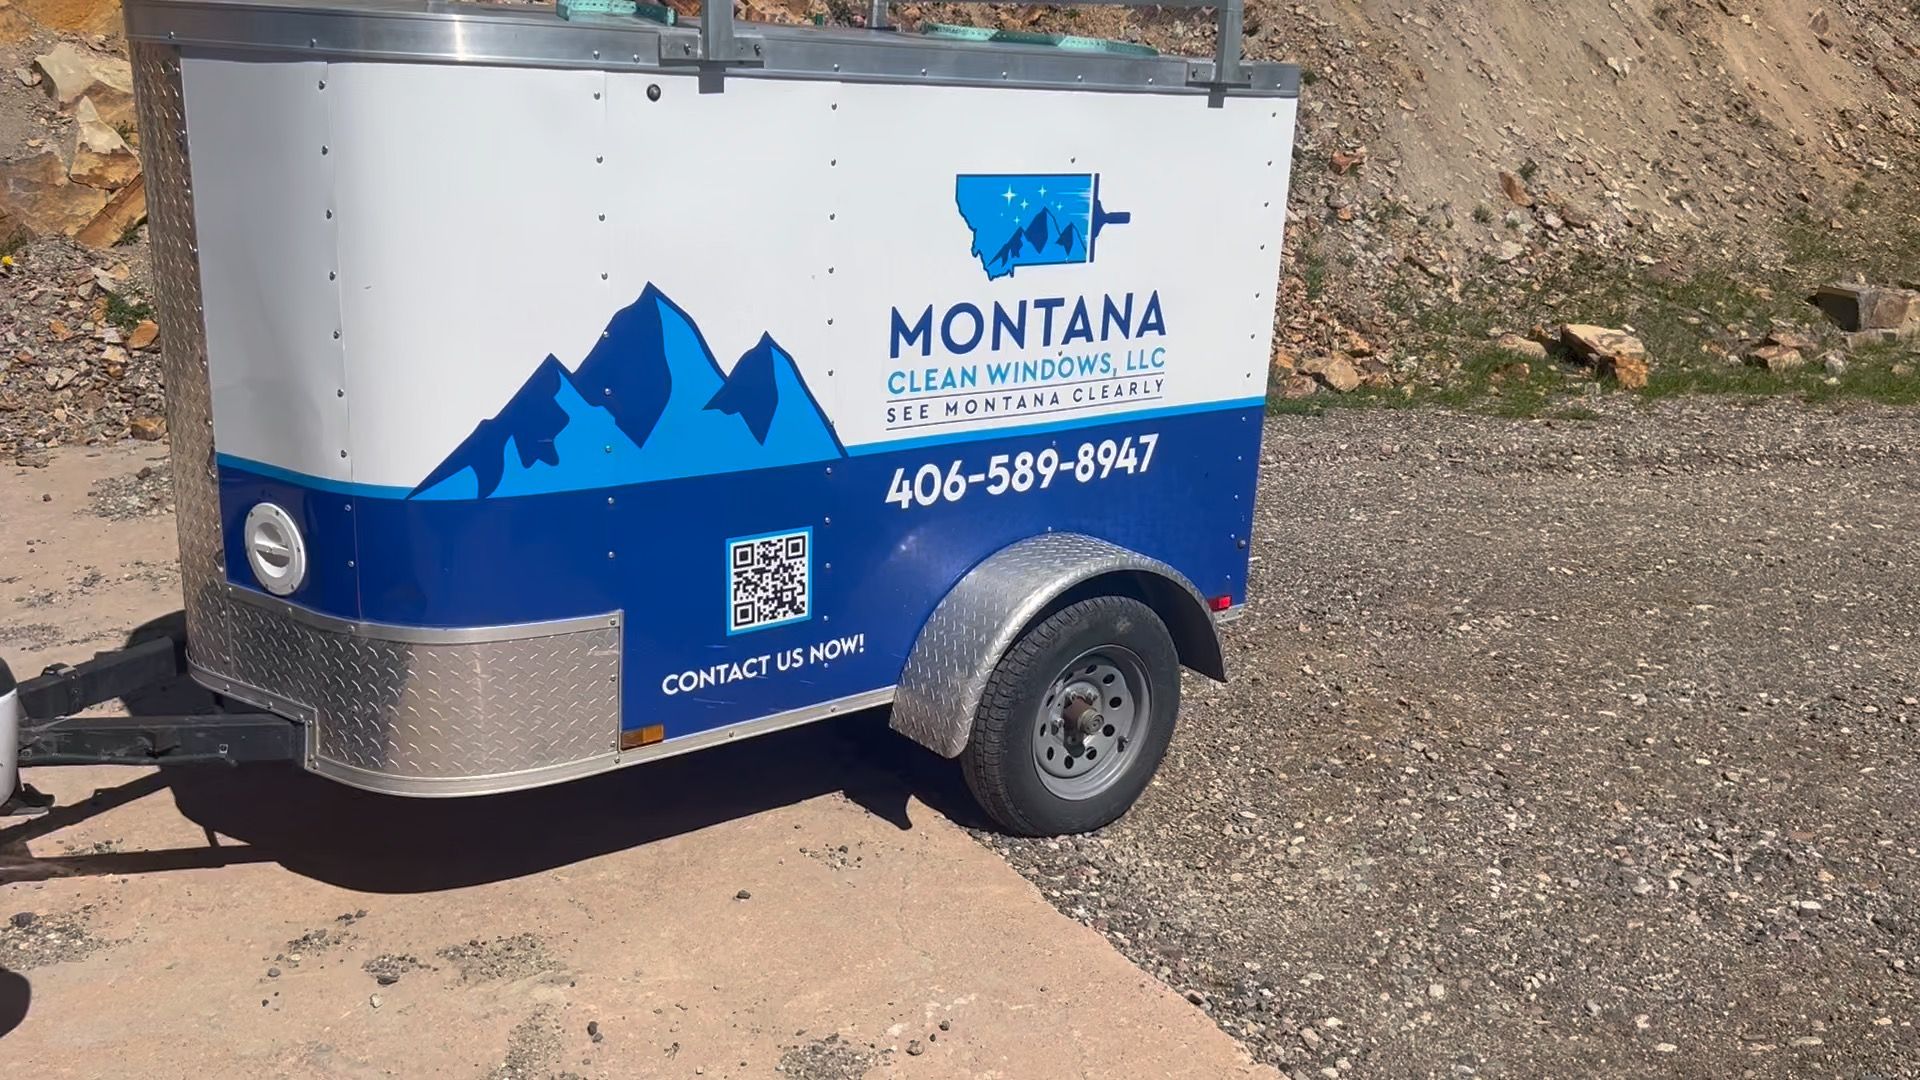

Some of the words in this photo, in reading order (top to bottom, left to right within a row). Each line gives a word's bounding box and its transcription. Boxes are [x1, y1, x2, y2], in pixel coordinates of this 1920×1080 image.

[889, 290, 1167, 359] MONTANA
[886, 407, 929, 423] SEE
[945, 391, 1060, 417] MONTANA
[1072, 378, 1165, 403] CLEARLY
[887, 364, 977, 395] CLEAN
[986, 352, 1118, 385] WINDOWS,
[1126, 347, 1166, 371] LLC
[885, 433, 1159, 509] 406-589-8947
[661, 654, 771, 696] CONTACT
[777, 648, 804, 671] US
[810, 633, 865, 664] NOW!
